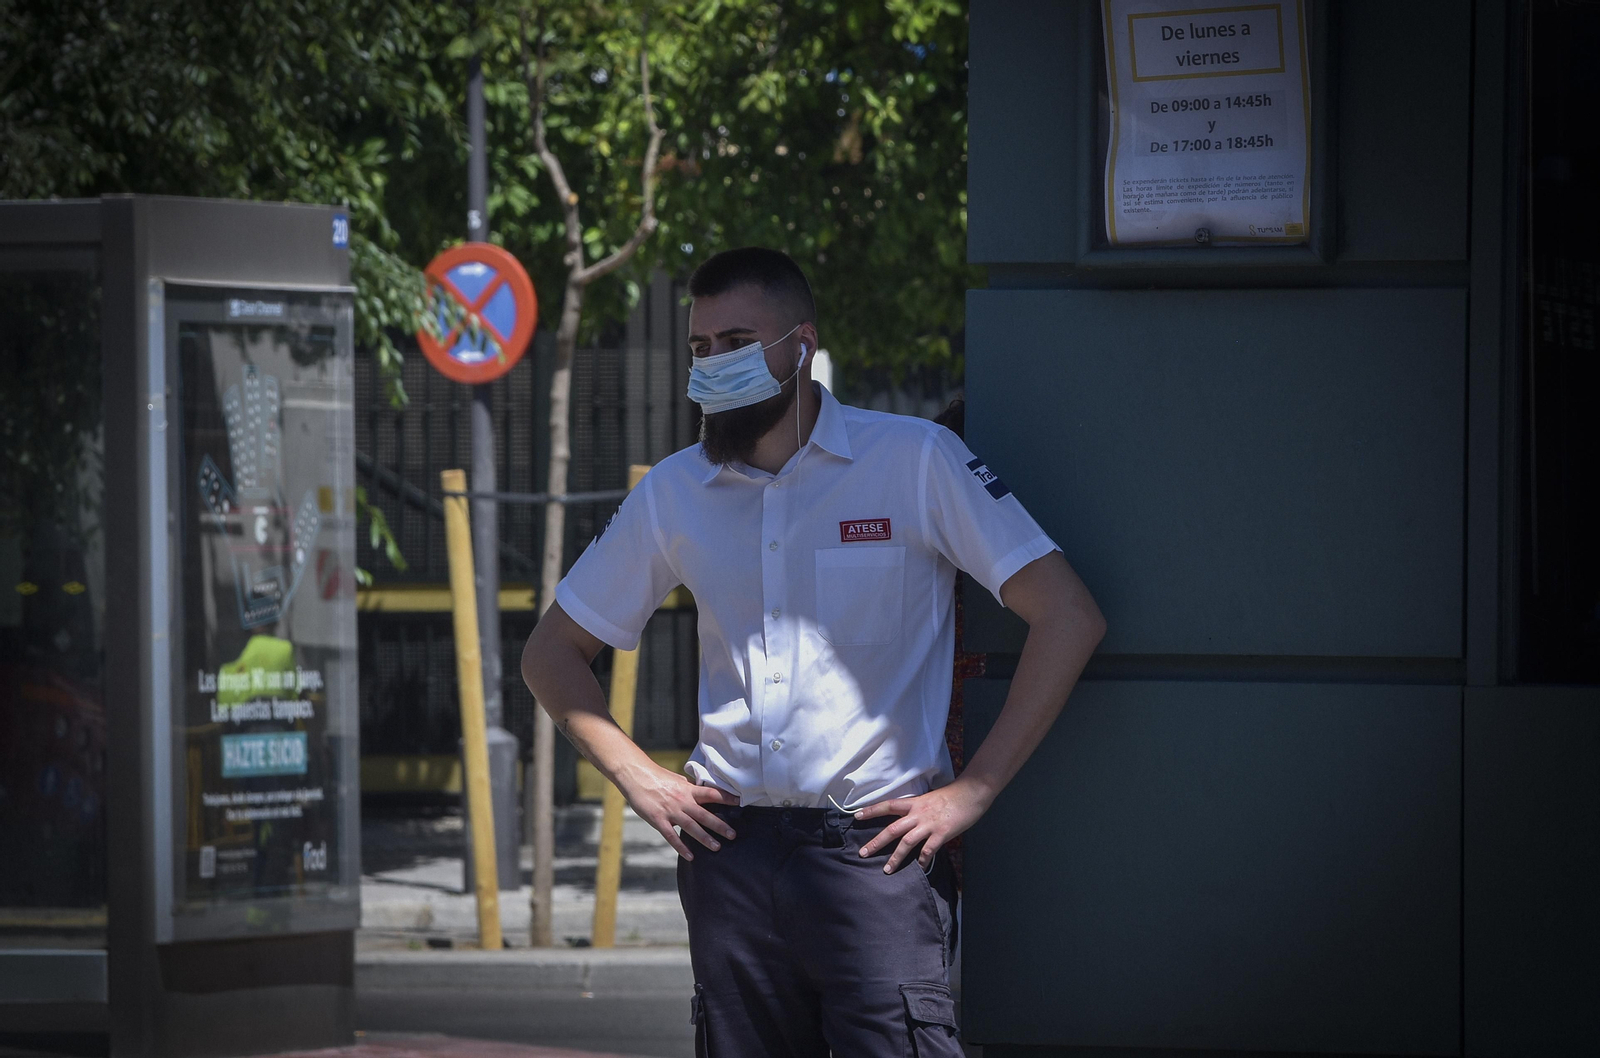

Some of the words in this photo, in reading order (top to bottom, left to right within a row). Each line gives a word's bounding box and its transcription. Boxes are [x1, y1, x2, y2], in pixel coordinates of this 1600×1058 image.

[1161, 25, 1184, 41] De
[1189, 22, 1236, 39] lunes
[1241, 23, 1251, 35] a
[1176, 50, 1240, 66] viernes
[1150, 101, 1168, 113] De
[1172, 98, 1210, 112] 09:00
[1214, 99, 1221, 109] a
[1225, 94, 1272, 108] 14:45h
[1208, 120, 1216, 133] y
[1150, 142, 1168, 153] De
[1172, 139, 1210, 151] 17:00
[1214, 140, 1222, 149] a
[1226, 134, 1274, 149] 18:45h
[333, 219, 348, 244] 20
[848, 524, 884, 533] ATESE
